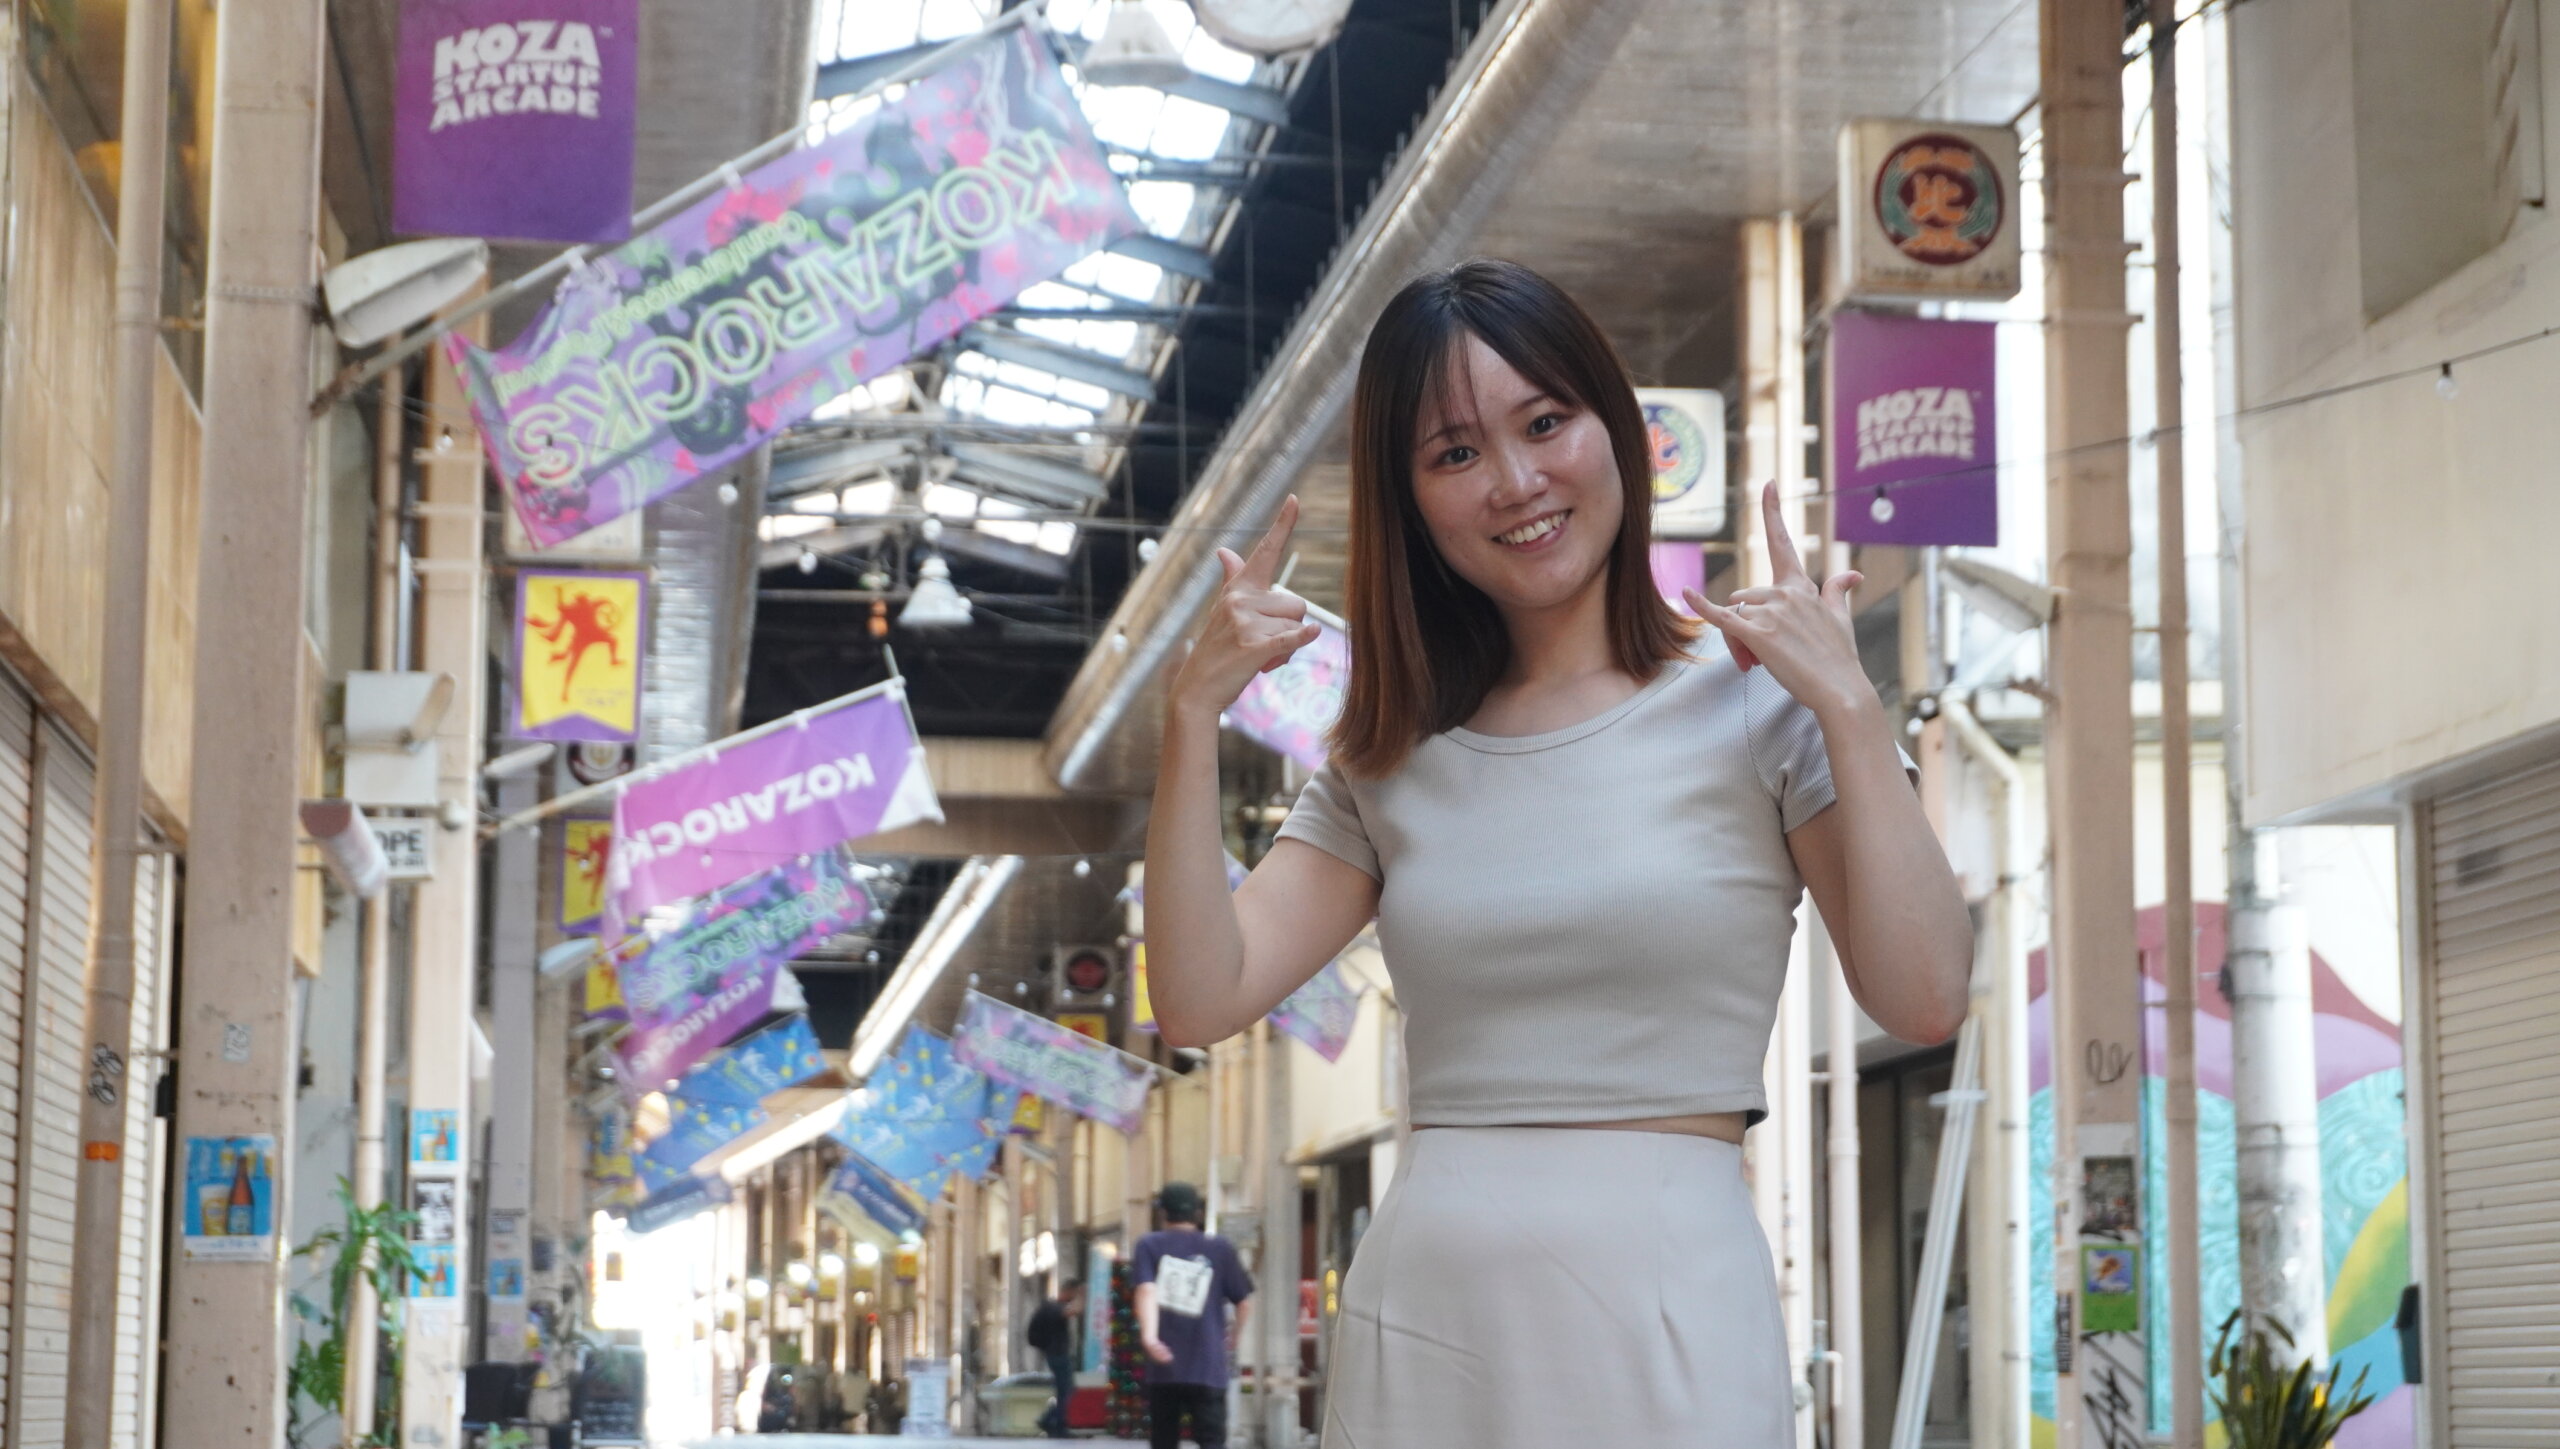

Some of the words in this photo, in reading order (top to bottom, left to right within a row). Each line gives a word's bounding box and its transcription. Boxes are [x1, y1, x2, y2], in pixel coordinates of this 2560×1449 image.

[433, 20, 601, 83] KOZA
[433, 62, 601, 102] STARTUP
[429, 85, 601, 133] ARCADE
[508, 128, 1079, 489] KOZAROCKS
[1857, 387, 1974, 433] KOZA
[1856, 434, 1975, 472] ARCADE
[614, 752, 876, 876] KOZAROCK
